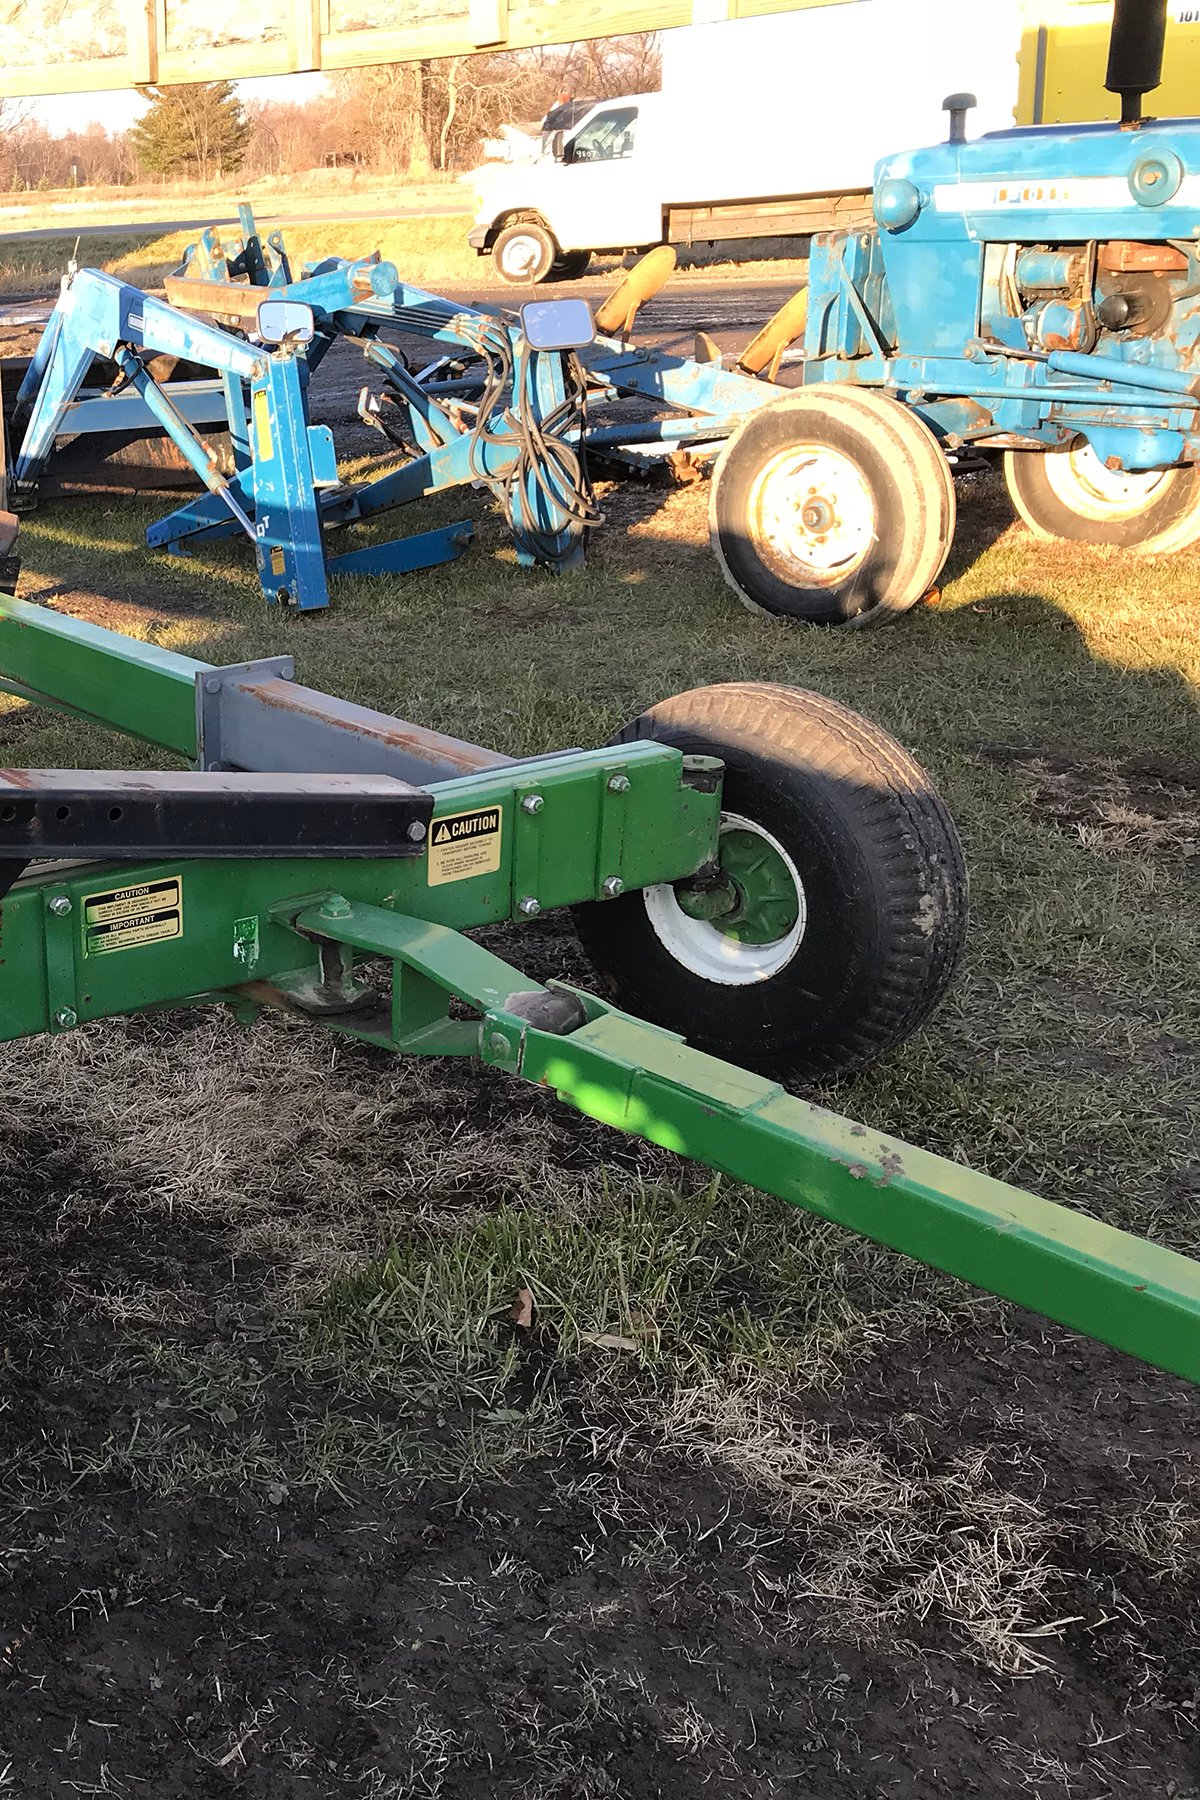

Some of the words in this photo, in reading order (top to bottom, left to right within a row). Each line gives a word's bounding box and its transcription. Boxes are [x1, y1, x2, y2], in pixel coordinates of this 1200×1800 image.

[452, 815, 497, 837] CAUTION
[114, 887, 150, 901] CAUTION
[110, 915, 155, 931] IMPORTANT
